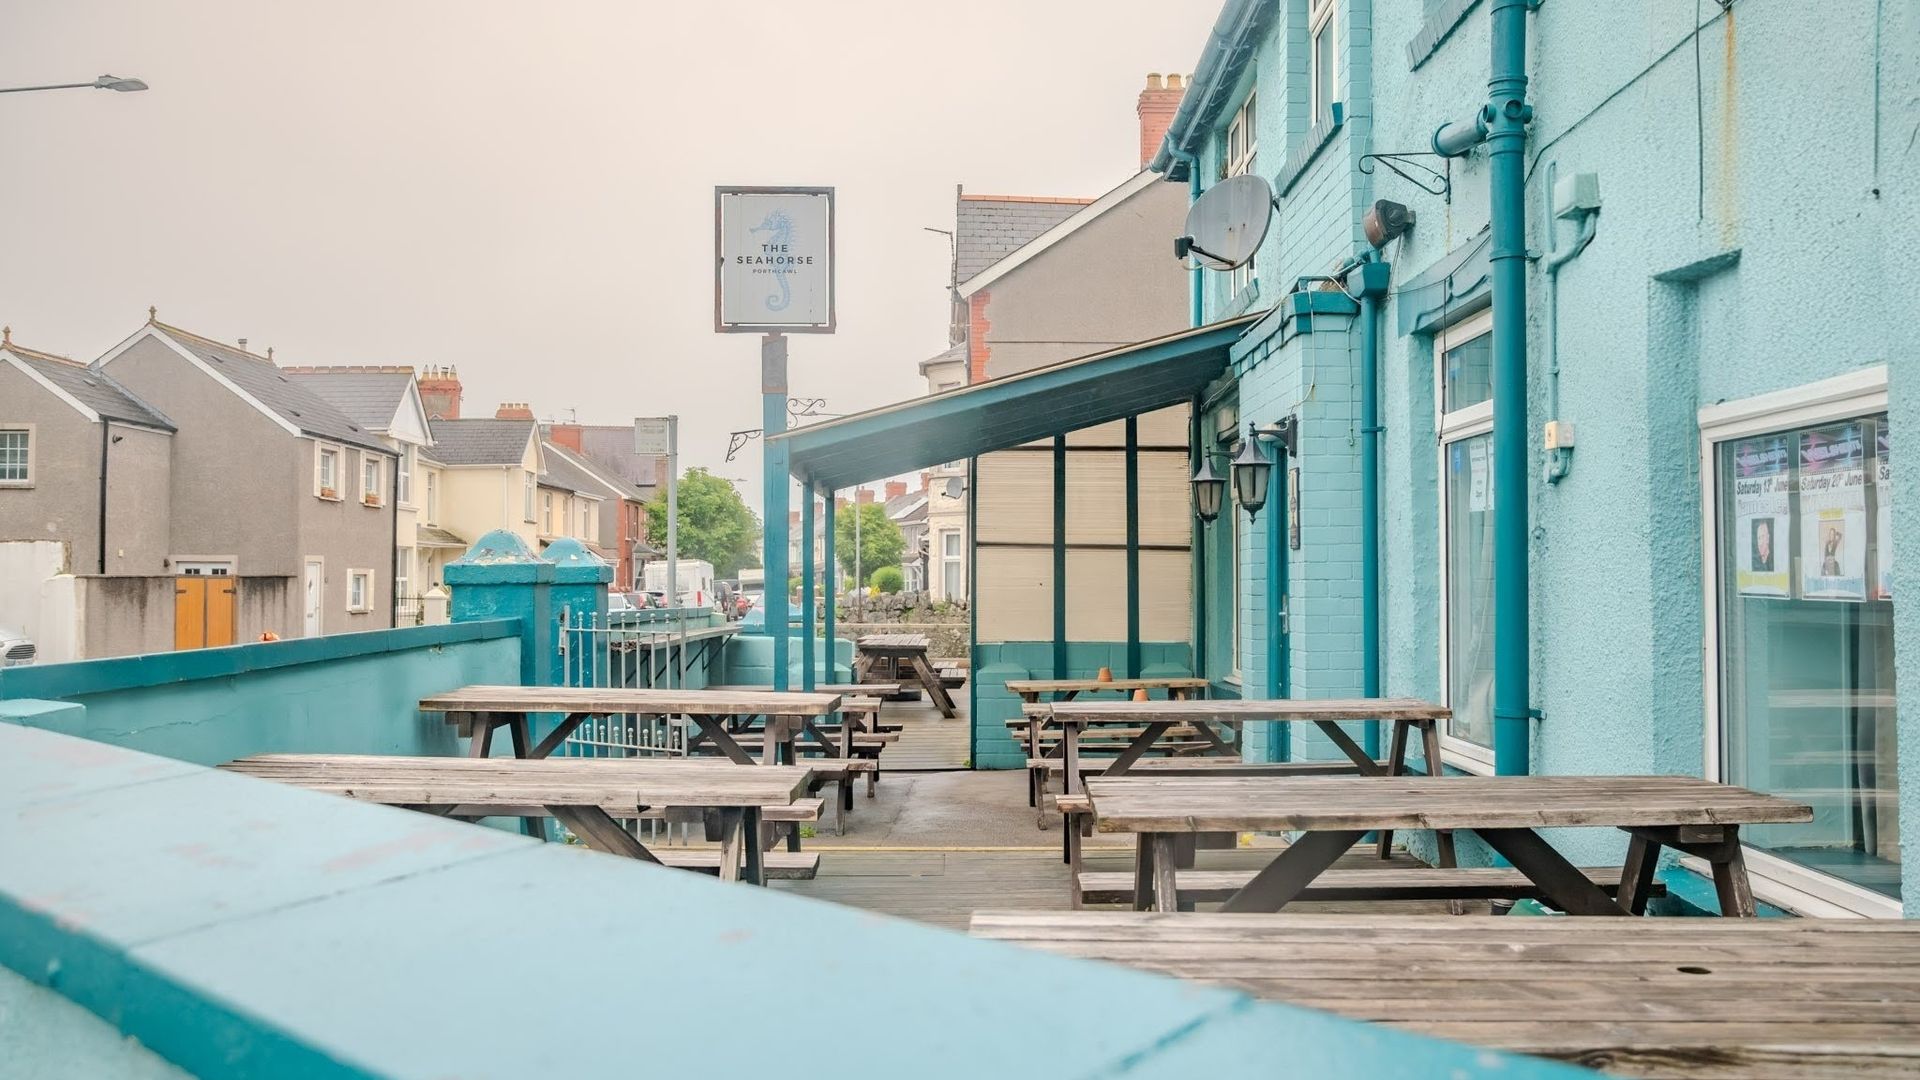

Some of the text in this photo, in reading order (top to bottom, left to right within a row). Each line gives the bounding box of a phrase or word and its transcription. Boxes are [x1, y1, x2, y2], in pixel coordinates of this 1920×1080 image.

[762, 244, 788, 252] THE
[737, 256, 813, 264] SEAHORSE
[1737, 479, 1762, 497] Saturday
[1774, 477, 1788, 493] June
[1801, 476, 1831, 493] Saturday
[1845, 471, 1863, 487] June
